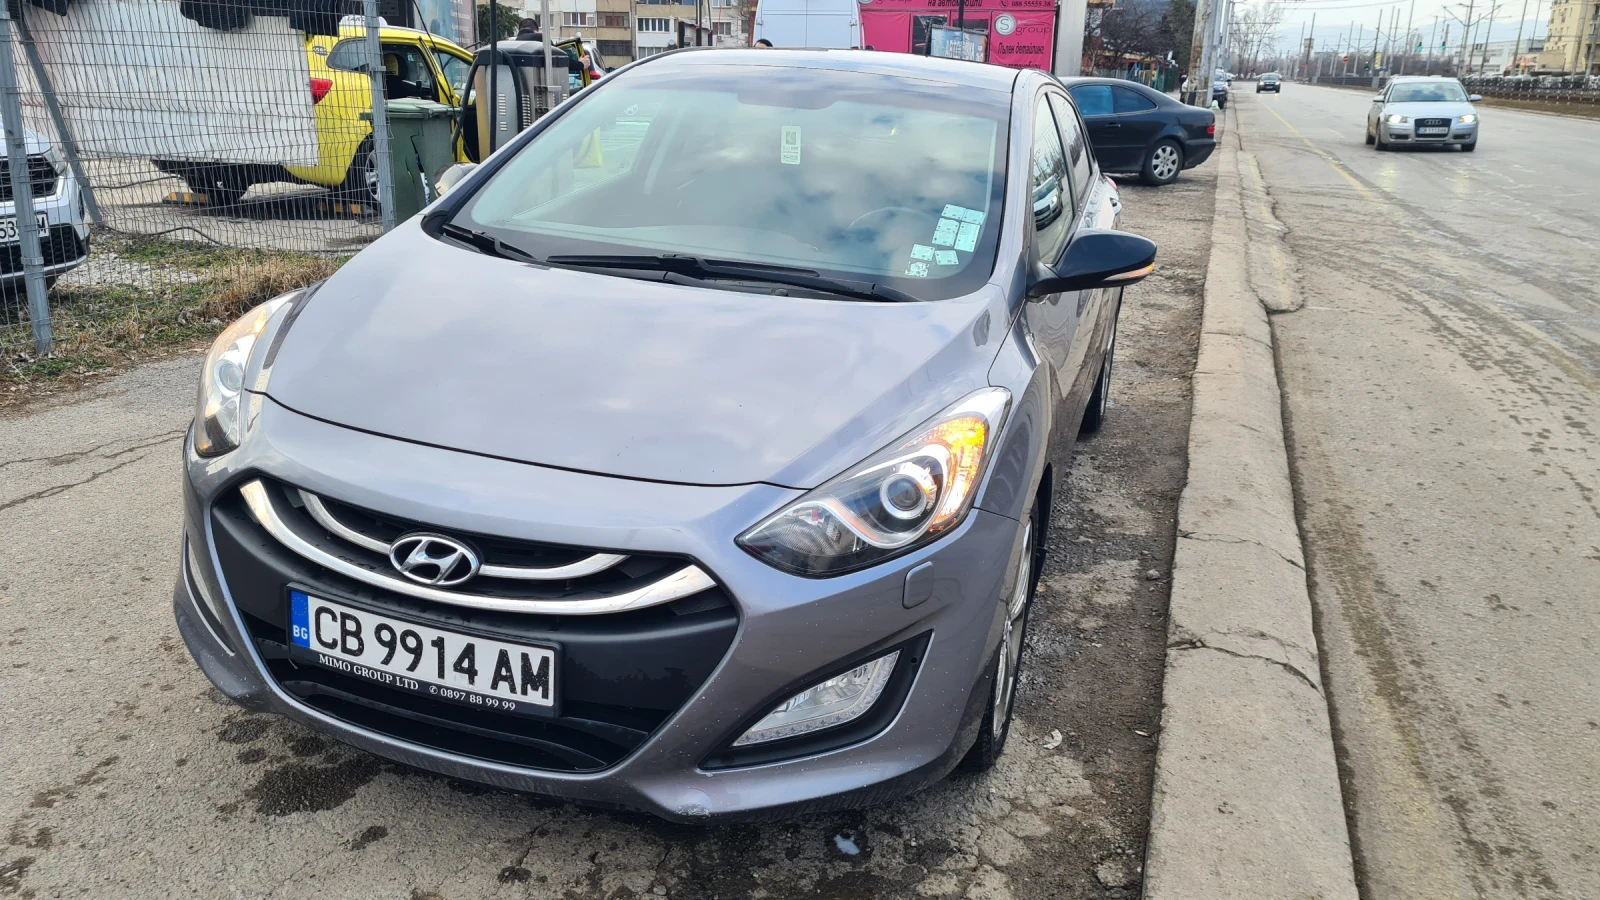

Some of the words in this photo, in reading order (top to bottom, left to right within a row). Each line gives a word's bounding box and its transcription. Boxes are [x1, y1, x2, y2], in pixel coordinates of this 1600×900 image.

[1015, 26, 1052, 36] group
[293, 625, 309, 640] BG
[314, 605, 365, 657] CB
[374, 622, 479, 686] 9914
[490, 648, 550, 700] AM
[319, 654, 351, 672] MIMO
[353, 665, 393, 684] GROUP
[395, 676, 419, 690] LTD
[440, 688, 466, 701] 0897
[469, 694, 483, 705] 88
[485, 697, 499, 708] 99
[502, 700, 516, 711] 99
